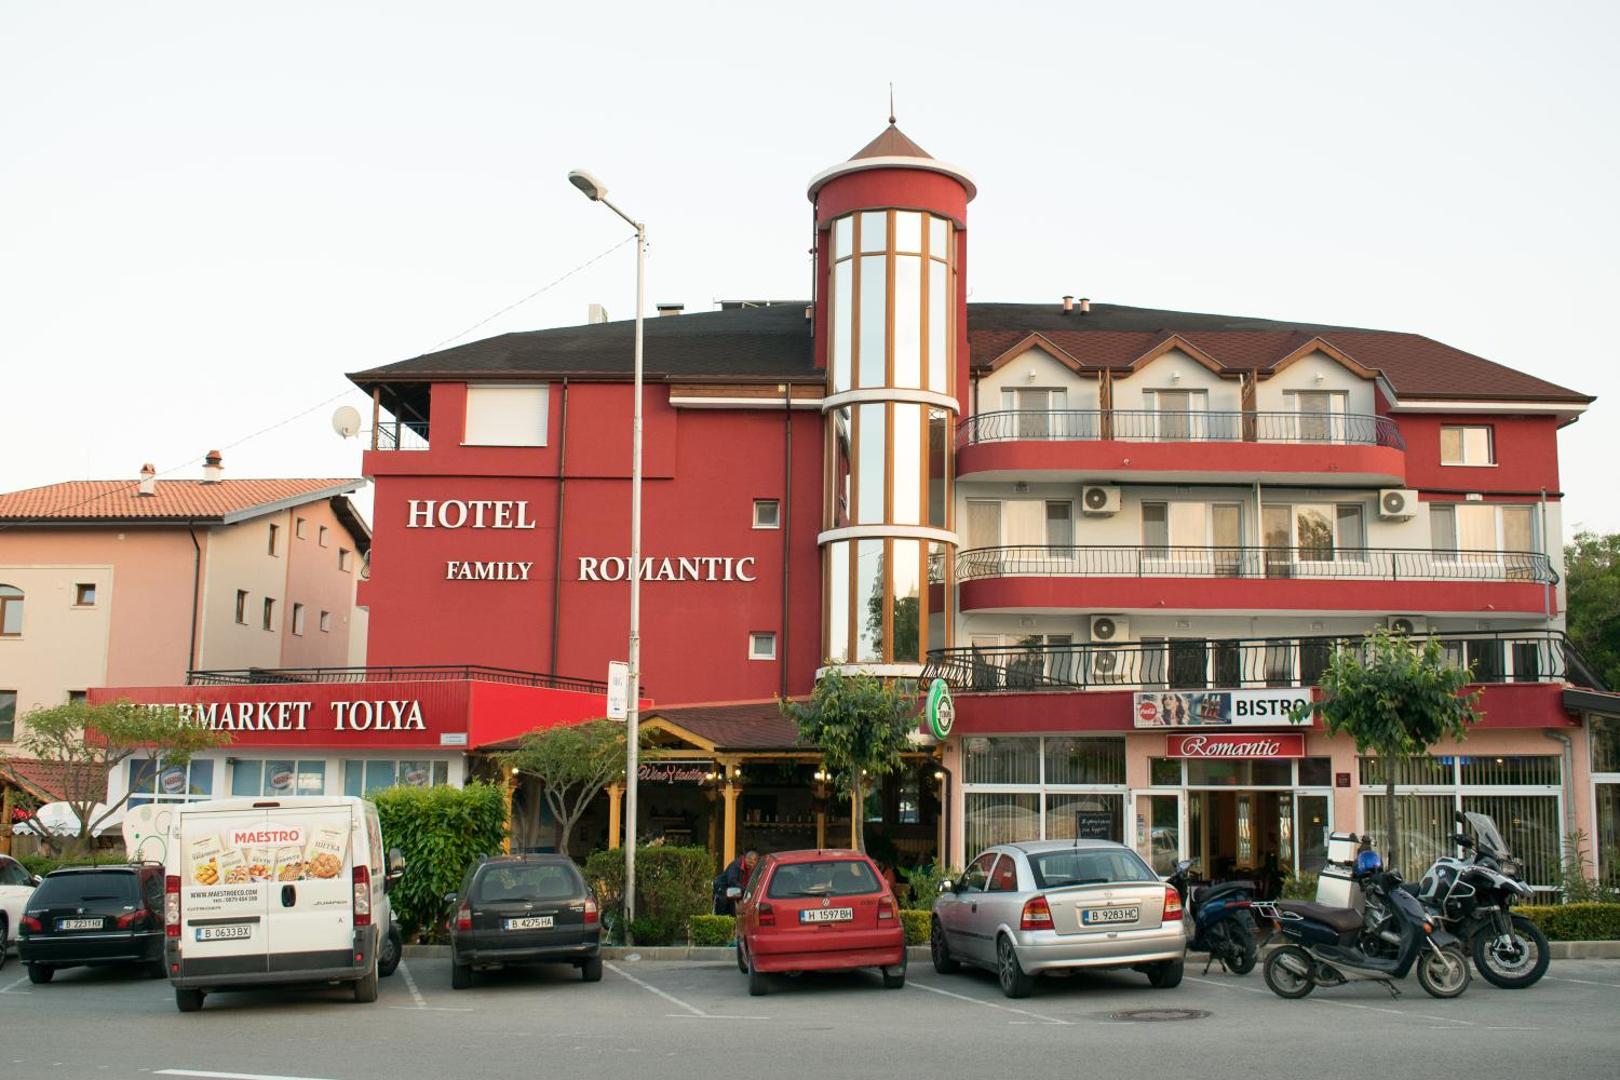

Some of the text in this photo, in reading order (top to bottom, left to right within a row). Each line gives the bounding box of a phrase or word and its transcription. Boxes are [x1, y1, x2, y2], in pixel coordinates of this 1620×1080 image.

[406, 499, 536, 529] HOTEL
[446, 556, 757, 582] FAMILY ROMANTIC
[117, 700, 426, 731] PERMARKET TOLYA
[1181, 735, 1280, 756] Romantic
[235, 830, 299, 844] MAESTRO
[808, 912, 815, 920] H
[1092, 911, 1099, 921] B
[205, 929, 211, 938] B
